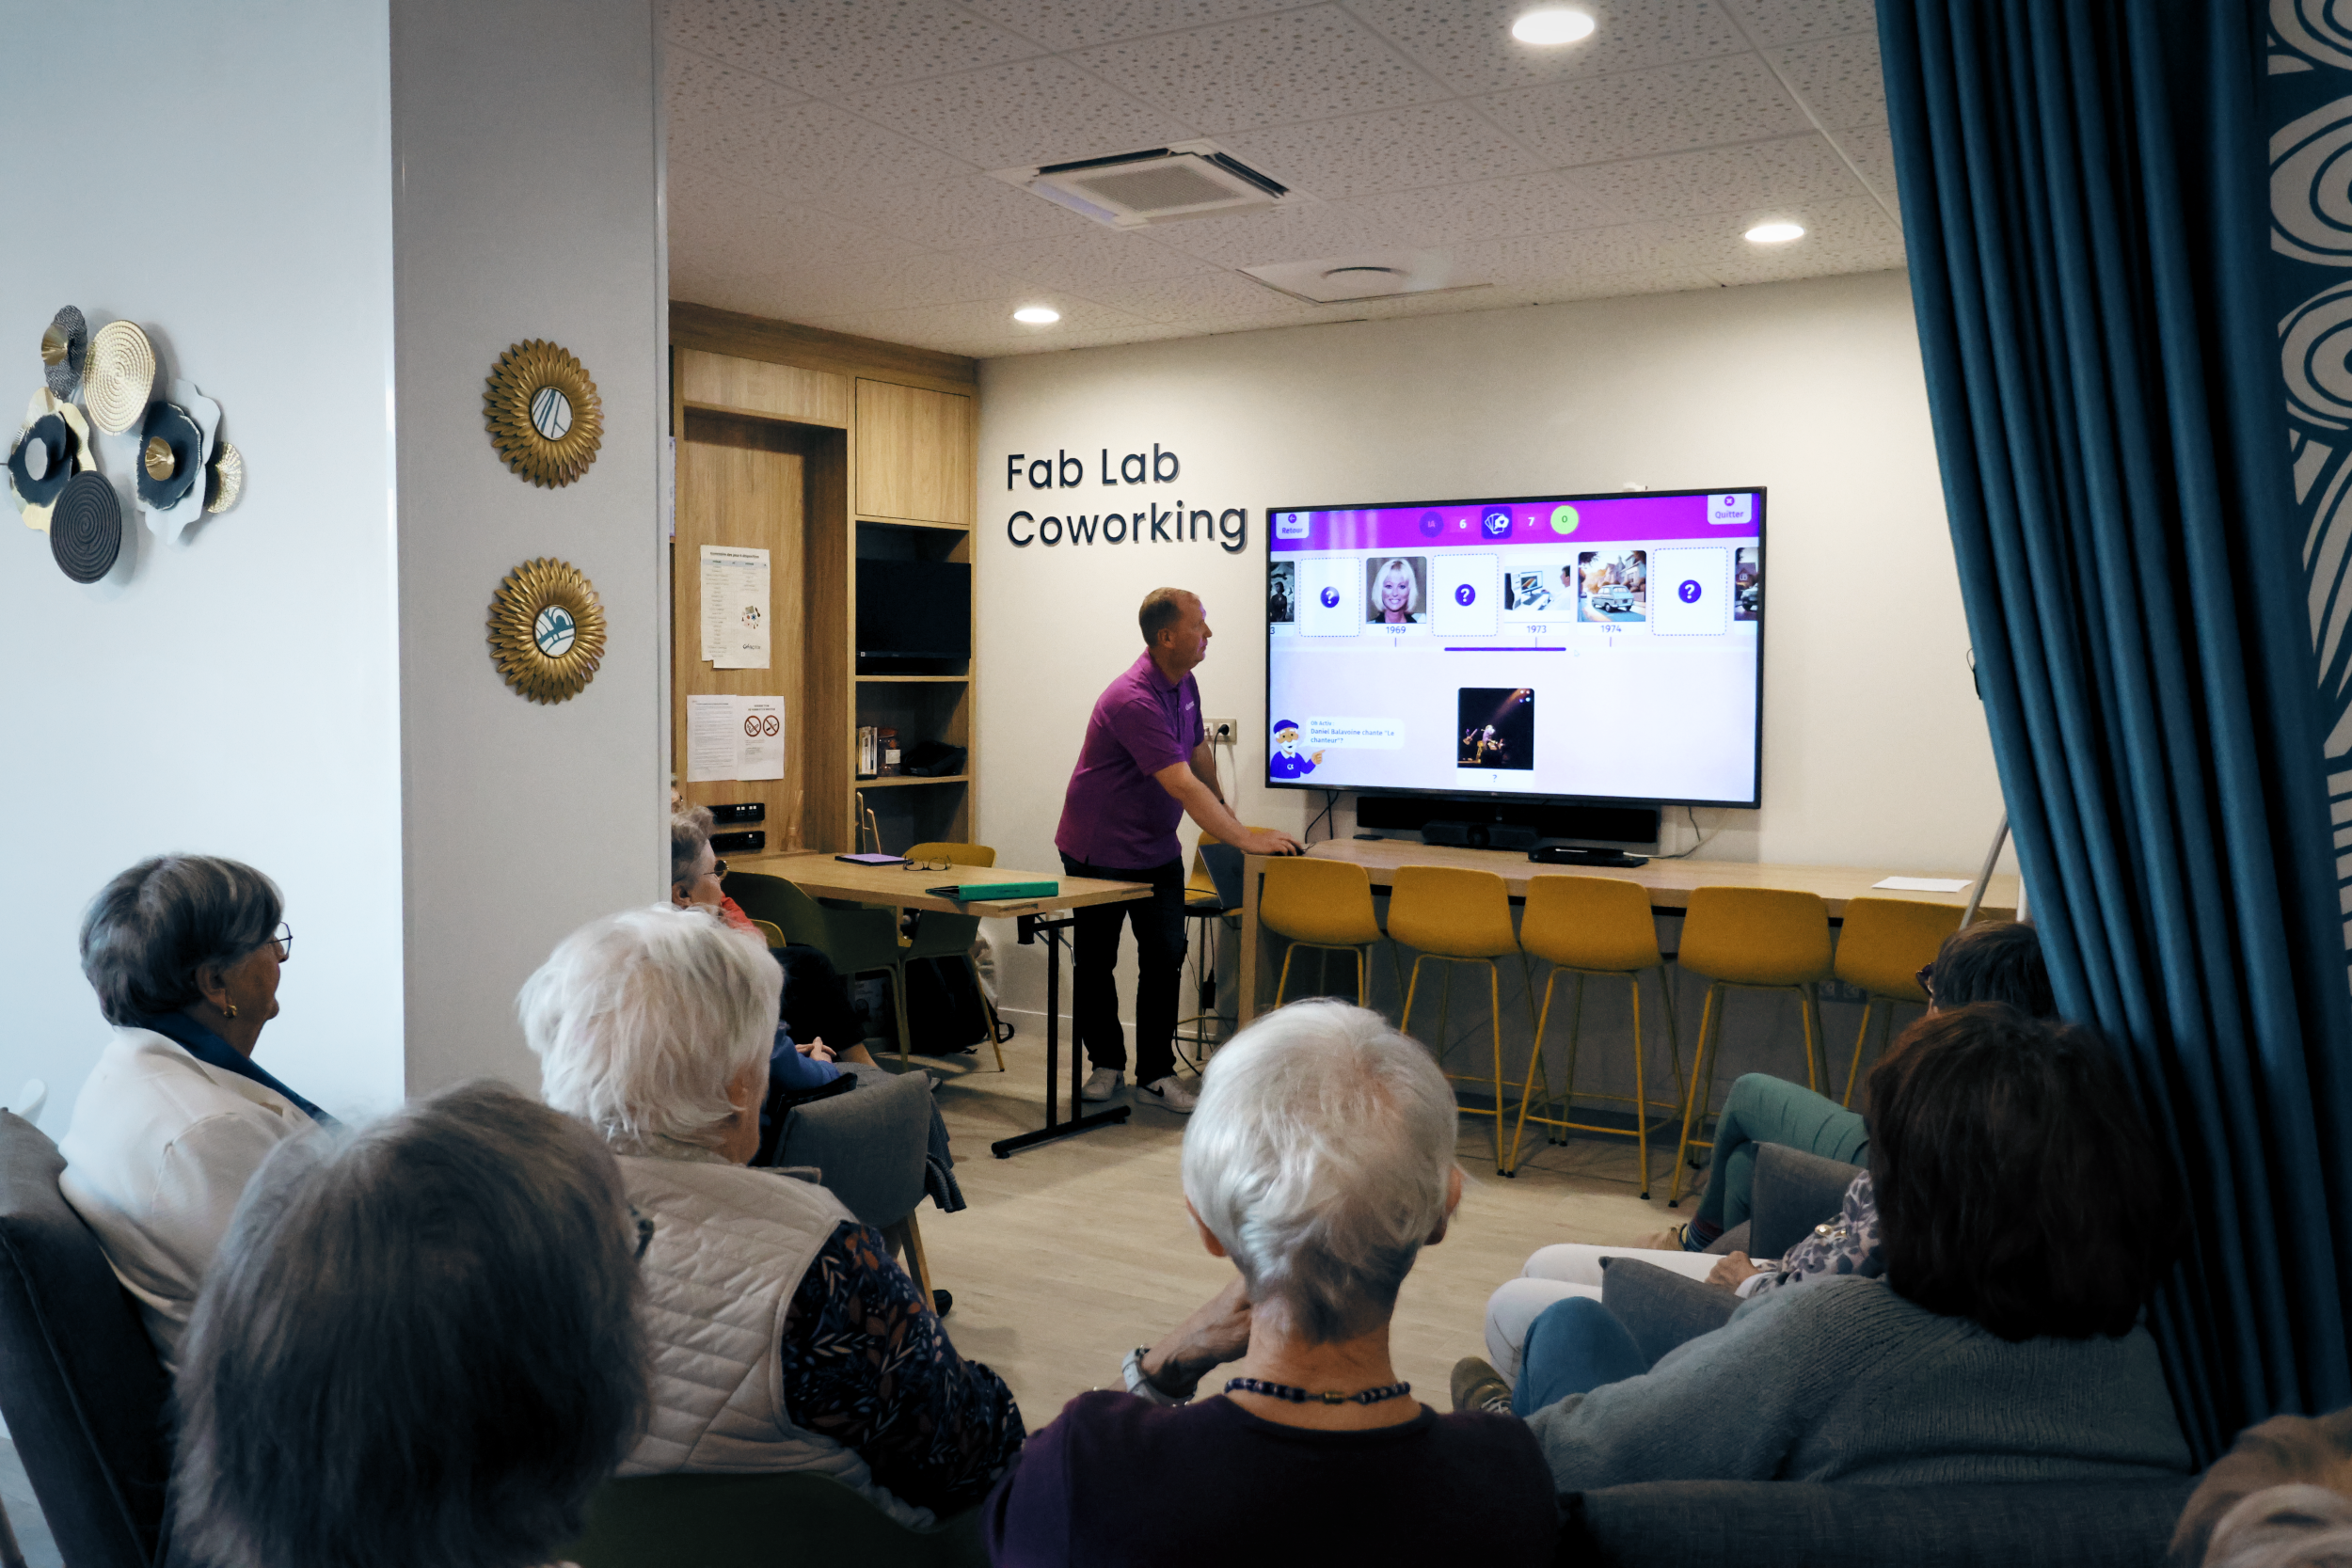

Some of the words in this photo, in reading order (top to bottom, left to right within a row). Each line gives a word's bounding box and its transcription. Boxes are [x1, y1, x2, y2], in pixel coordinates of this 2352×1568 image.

[1007, 449, 1084, 491] Fab
[1102, 442, 1180, 486] Lab
[1714, 511, 1744, 519] Quitter
[1459, 519, 1467, 529] 6
[1528, 516, 1535, 527] 7
[1007, 499, 1248, 554] Coworking
[1526, 625, 1547, 633] 1973
[1600, 625, 1622, 633] 1974
[1492, 774, 1498, 783] ?
